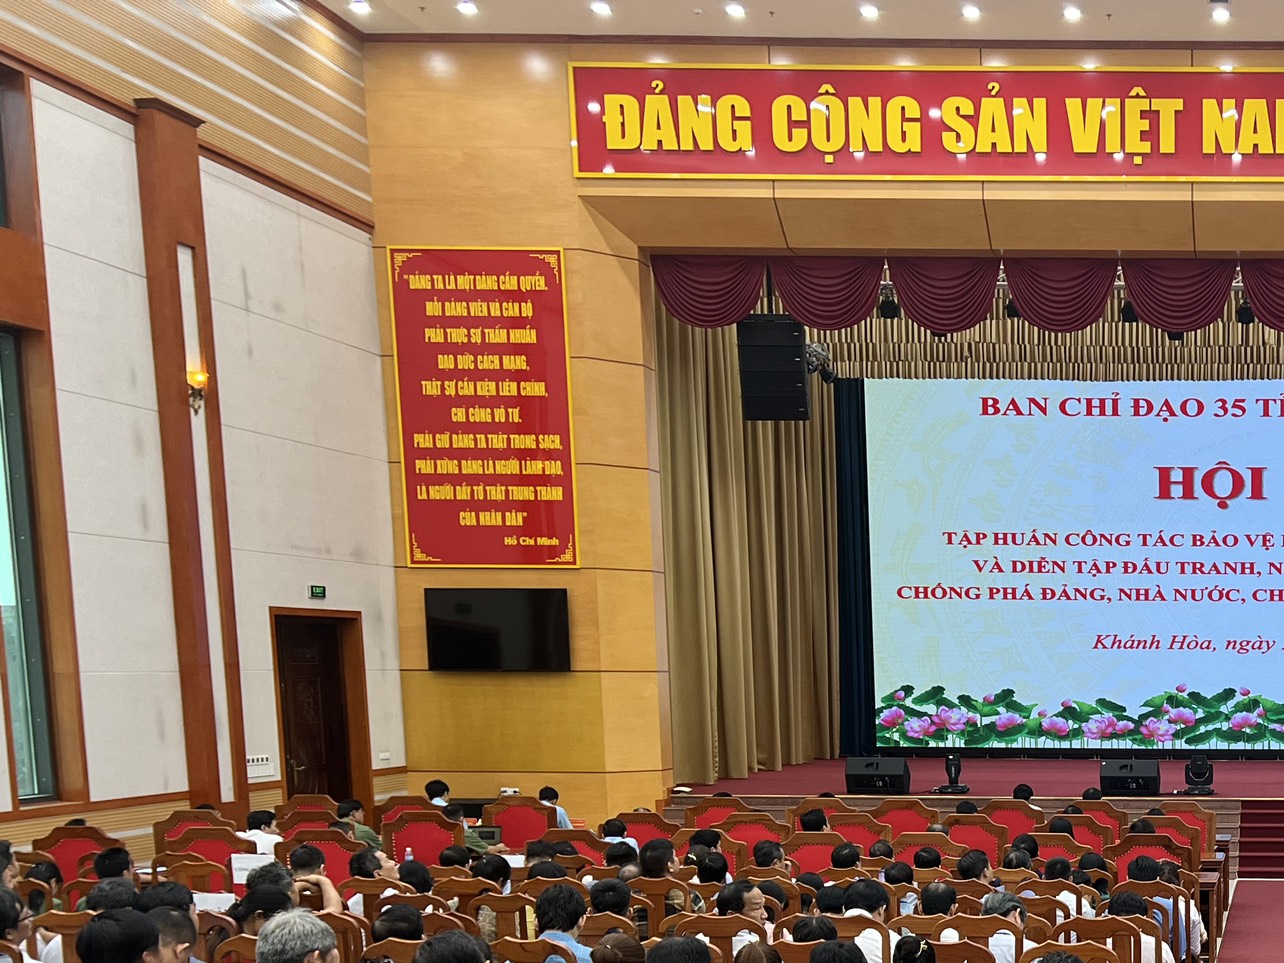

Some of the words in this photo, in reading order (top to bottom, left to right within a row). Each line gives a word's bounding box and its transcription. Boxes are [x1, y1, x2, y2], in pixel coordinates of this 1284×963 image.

[603, 80, 751, 152] ĐẢNG
[772, 84, 922, 163] CỘNG
[942, 82, 1047, 154] SẢN
[1065, 86, 1183, 164] VIỆT
[445, 298, 467, 316] ĐẢNG
[469, 299, 488, 316] VIÊN
[489, 299, 501, 316] VÀ
[502, 300, 519, 317] CÁN
[521, 300, 532, 319] BỘ
[438, 355, 454, 371] ĐẠO
[457, 352, 474, 369] ĐỨC
[477, 352, 500, 369] CÁCH
[503, 355, 529, 371] MẠNG,
[469, 405, 492, 422] CÔNG
[494, 405, 505, 422] VÔ
[508, 407, 521, 422] TƯ.
[979, 398, 1048, 417] BAN
[1059, 392, 1121, 417] CHỈ
[1130, 398, 1204, 422] ĐẠO
[1213, 398, 1247, 417] 35
[414, 430, 433, 448] PHẢI
[452, 431, 474, 448] ĐẢNG
[476, 434, 486, 448] TA
[487, 432, 507, 450] THẬT
[510, 435, 536, 450] TRONG
[539, 435, 562, 450] SẠCH,
[416, 456, 434, 473] PHẢI
[461, 456, 483, 474] ĐÁNG
[484, 457, 494, 474] LÀ
[522, 458, 544, 474] LÃNH
[1154, 461, 1268, 510] HỘI
[460, 508, 476, 525] CỦA
[479, 510, 502, 525] NHÂN
[943, 531, 987, 549] TẬP
[993, 529, 1058, 547] HUẤN
[1065, 530, 1132, 547] CÔNG
[1138, 530, 1185, 547] TÁC
[1191, 530, 1239, 547] BẢO
[1245, 533, 1275, 551] VỆ
[973, 558, 1003, 574] VÀ
[1011, 557, 1066, 574] DIỄN
[1073, 559, 1117, 578] TẬP
[1123, 558, 1169, 575] ĐẤU
[1176, 561, 1262, 578] TRANH,
[896, 583, 981, 600] CHỐNG
[987, 585, 1035, 601] PHÁ
[1041, 584, 1112, 602] ĐẢNG,
[1118, 586, 1167, 602] NHÀ
[1174, 585, 1246, 604] NƯỚC,
[1092, 634, 1161, 651] Khánh
[1167, 636, 1217, 653] Hòa,
[1224, 639, 1275, 655] ngày
